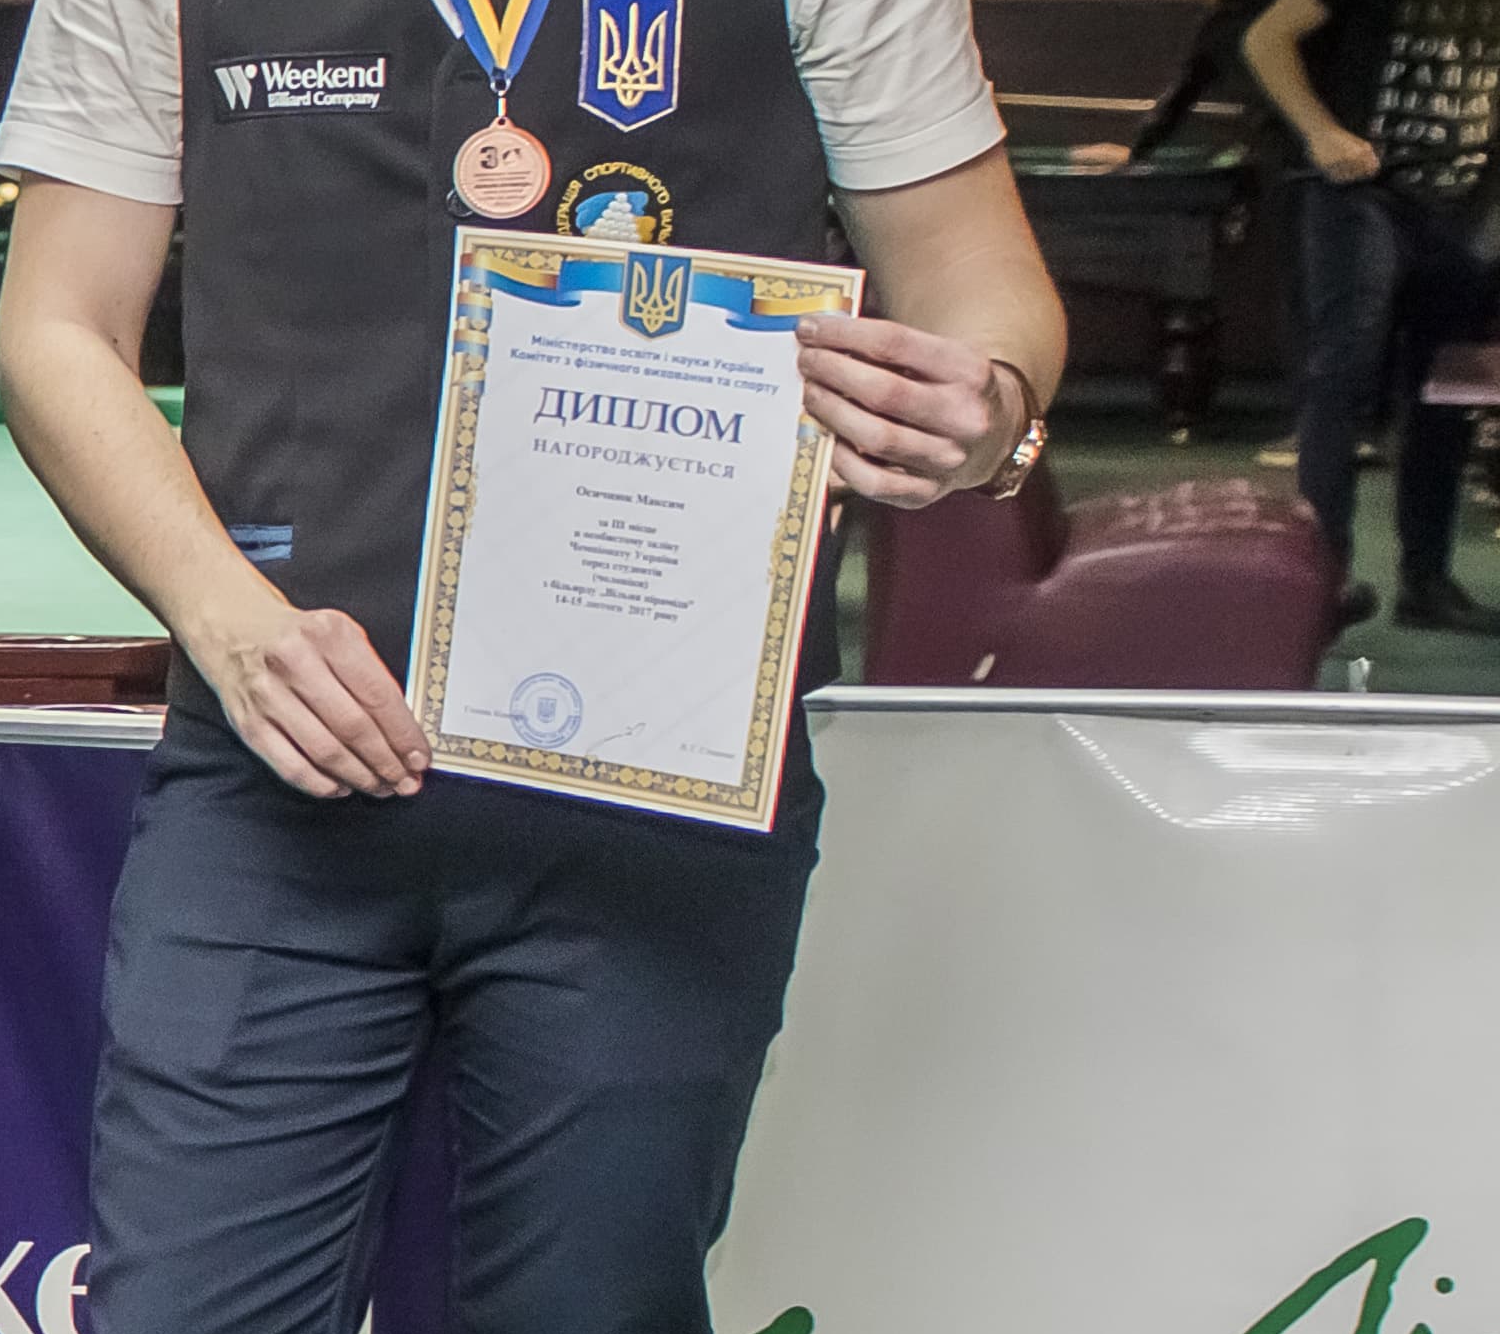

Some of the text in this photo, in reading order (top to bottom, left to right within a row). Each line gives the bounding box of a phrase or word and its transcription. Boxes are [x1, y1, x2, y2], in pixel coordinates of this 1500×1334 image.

[261, 58, 387, 91] Weekend
[312, 90, 380, 109] Company
[510, 348, 561, 364] Комітет
[574, 356, 640, 375] фізичного
[717, 375, 730, 387] та
[733, 378, 780, 395] спорту
[531, 334, 616, 356] Міністерство
[619, 347, 661, 361] освіти
[671, 353, 709, 368] науки
[713, 358, 765, 375] України
[533, 386, 745, 444] ДИПЛОМ
[532, 438, 735, 479] НАГОРОДЖУЄТЬСЯ
